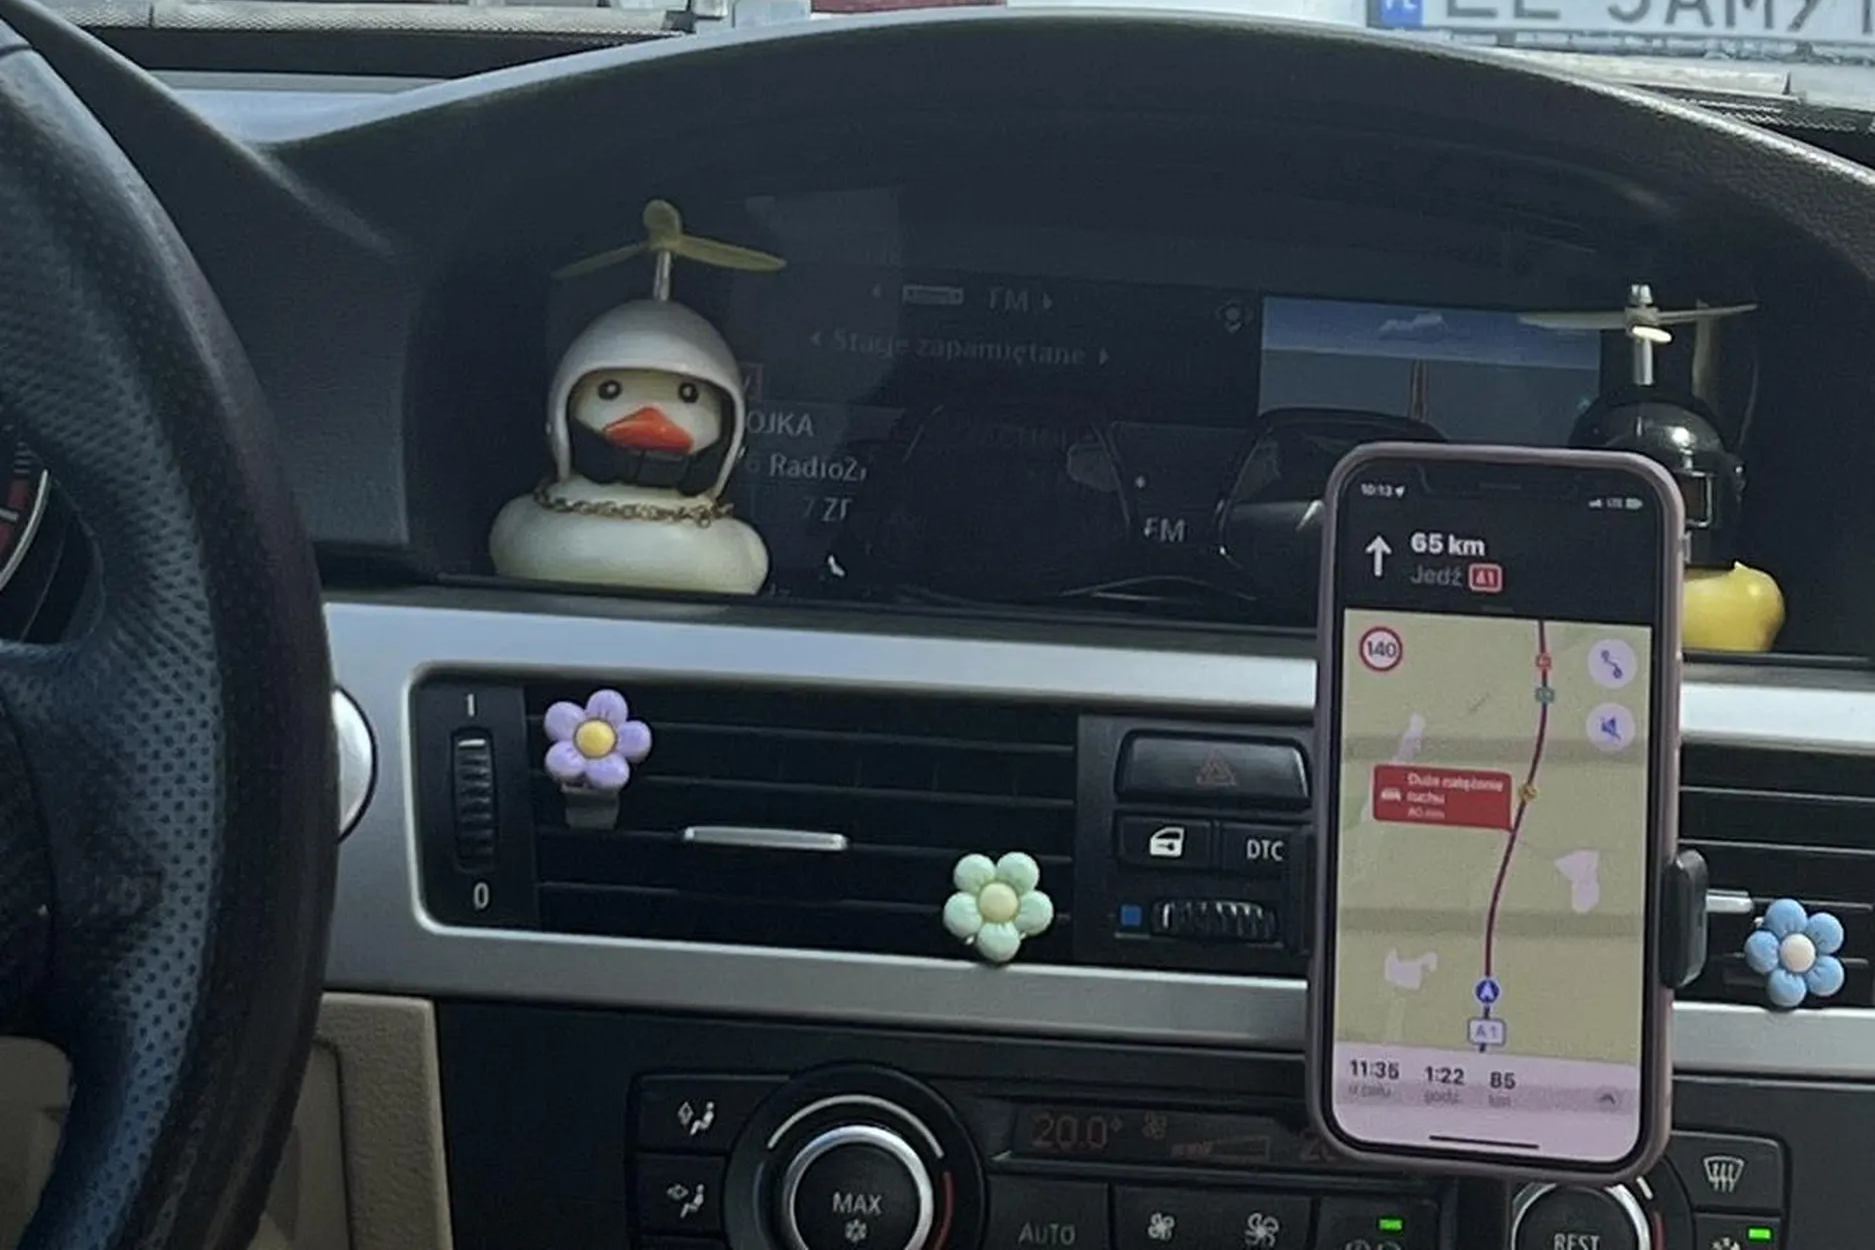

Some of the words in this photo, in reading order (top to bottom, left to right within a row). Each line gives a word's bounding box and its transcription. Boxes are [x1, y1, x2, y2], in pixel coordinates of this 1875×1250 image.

[1410, 532, 1444, 554] 65
[1449, 535, 1486, 557] km
[1366, 639, 1398, 659] 140
[1246, 838, 1285, 862] DTC
[1425, 1065, 1466, 1085] 1:22
[832, 1191, 882, 1216] MAX
[1017, 1221, 1076, 1246] AUTO
